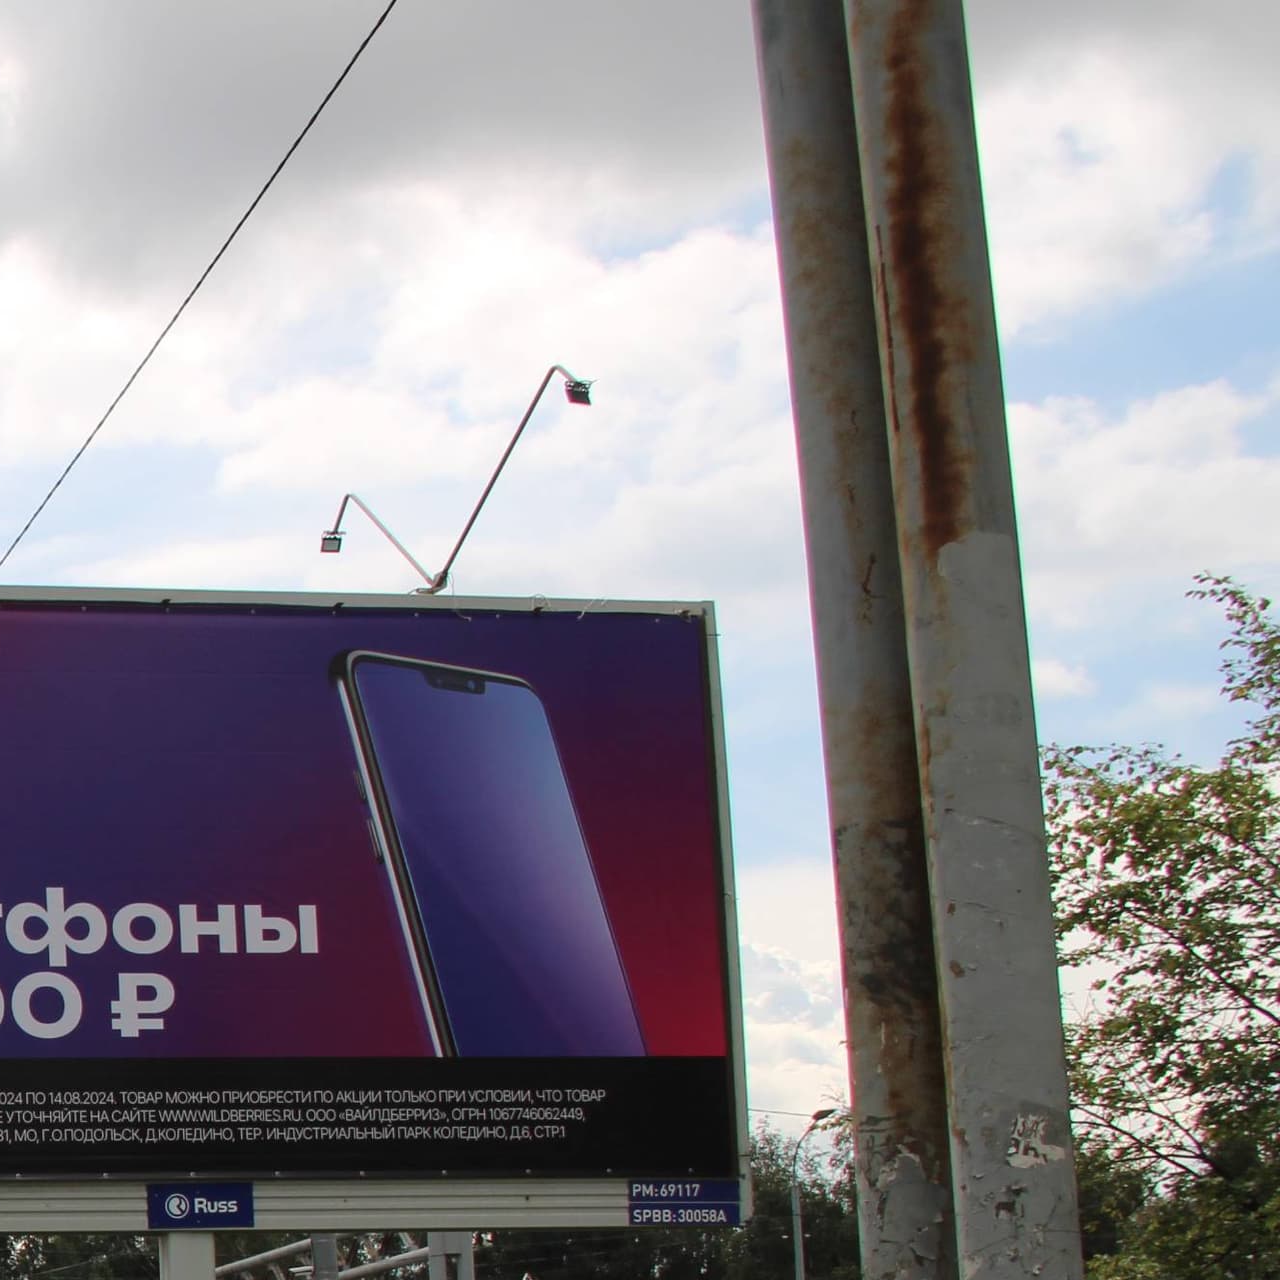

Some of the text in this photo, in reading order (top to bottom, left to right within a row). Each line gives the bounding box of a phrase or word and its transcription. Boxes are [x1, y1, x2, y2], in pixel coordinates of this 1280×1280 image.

[110, 972, 176, 1038] ₽
[25, 1092, 46, 1105] ПО
[49, 1092, 117, 1105] 14.08.2024.
[120, 1091, 163, 1104] ТОВАР
[165, 1091, 220, 1104] МОЖНО
[222, 1091, 312, 1104] ПРИОБРЕСТИ
[314, 1091, 333, 1103] ПО
[336, 1091, 382, 1105] АКЦИИ
[384, 1090, 437, 1103] ТОЛЬКО
[439, 1090, 465, 1103] ПРИ
[468, 1090, 534, 1105] УСЛОВИИ,
[536, 1090, 562, 1102] ЧТО
[565, 1090, 606, 1102] ТОВАР
[6, 1108, 87, 1124] УТОЧНЯЙТЕ
[90, 1110, 109, 1123] НА
[111, 1107, 156, 1123] САЙТЕ
[158, 1109, 304, 1122] WWW.WILDBERRIES.RU.
[306, 1109, 337, 1122] ООО
[339, 1106, 450, 1123] «ВАЙЛДБЕРРИЗ»,
[452, 1108, 486, 1121] ОГРН
[15, 1129, 39, 1144] МО,
[237, 1128, 263, 1141] ТЕР.
[267, 1125, 394, 1142] ИНДУСТРИАЛЬНЫЙ
[398, 1127, 430, 1140] ПАРК
[434, 1126, 508, 1141] КОЛЕДИНО,
[194, 1198, 238, 1213] Russ
